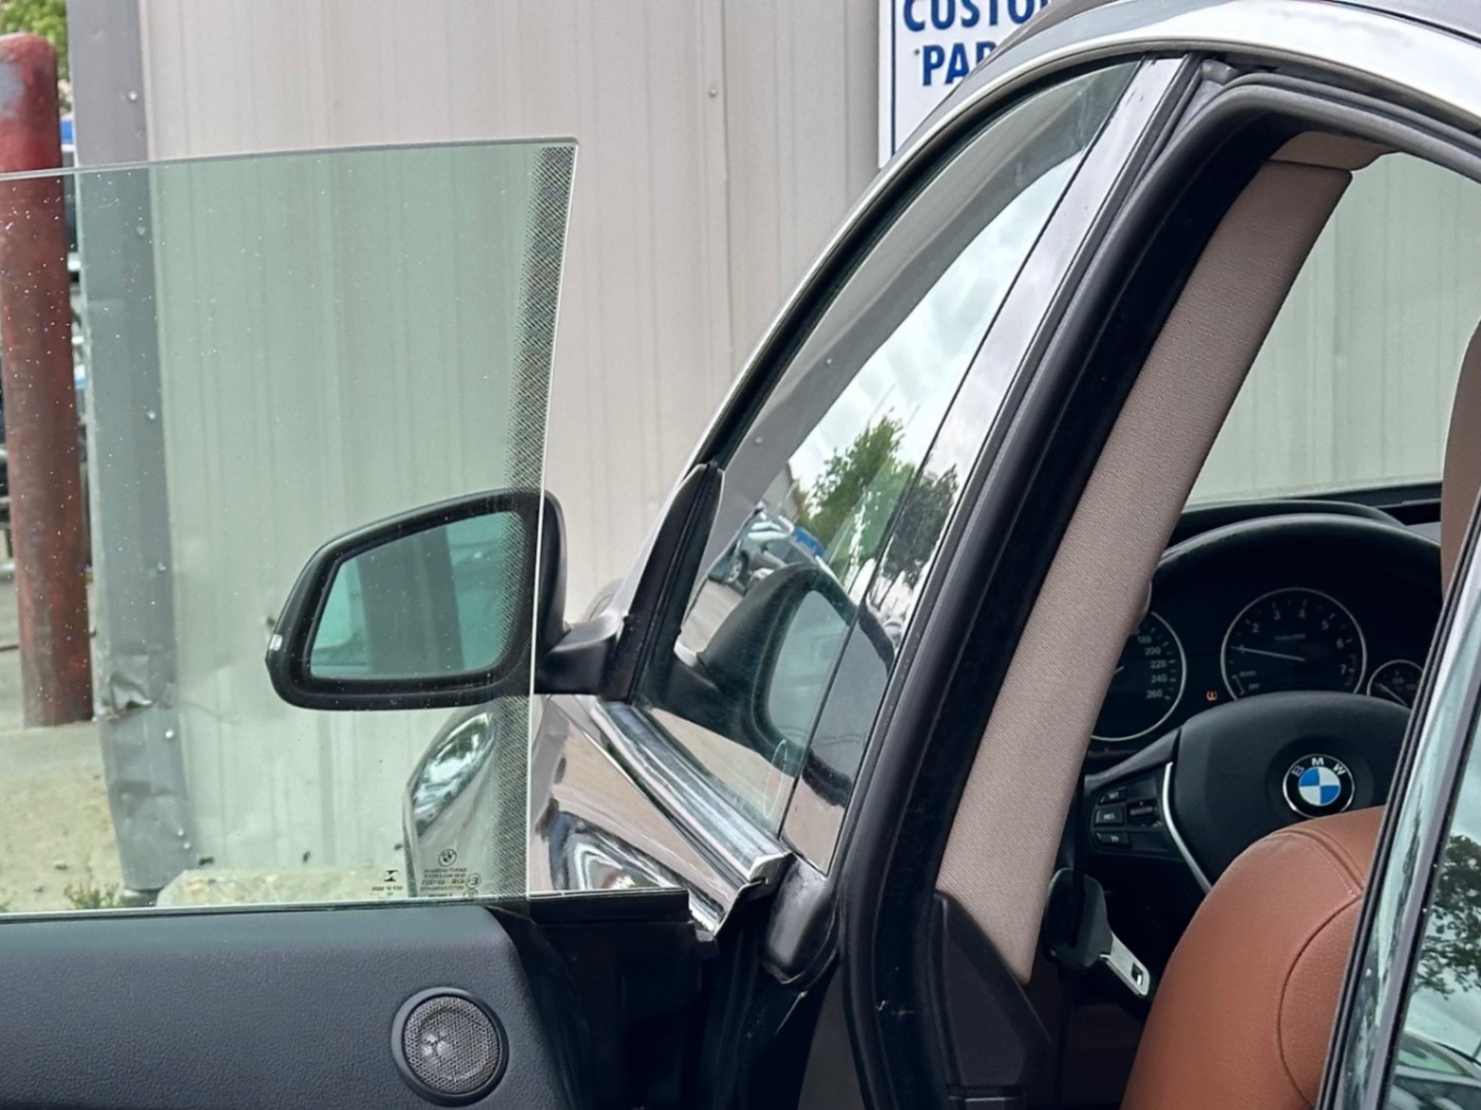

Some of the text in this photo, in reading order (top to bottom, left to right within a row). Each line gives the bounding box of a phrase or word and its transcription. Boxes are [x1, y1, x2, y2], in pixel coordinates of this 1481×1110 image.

[903, 0, 1048, 32] CUSTO
[1273, 610, 1281, 620] 3
[1298, 608, 1306, 618] 4
[1252, 623, 1259, 633] 2
[1321, 620, 1329, 630] 5
[1336, 638, 1344, 649] 6
[1144, 646, 1162, 657] 200
[1150, 659, 1168, 670] 220
[1340, 664, 1347, 675] 7
[1150, 673, 1168, 684] 240
[1291, 756, 1346, 777] BMW
